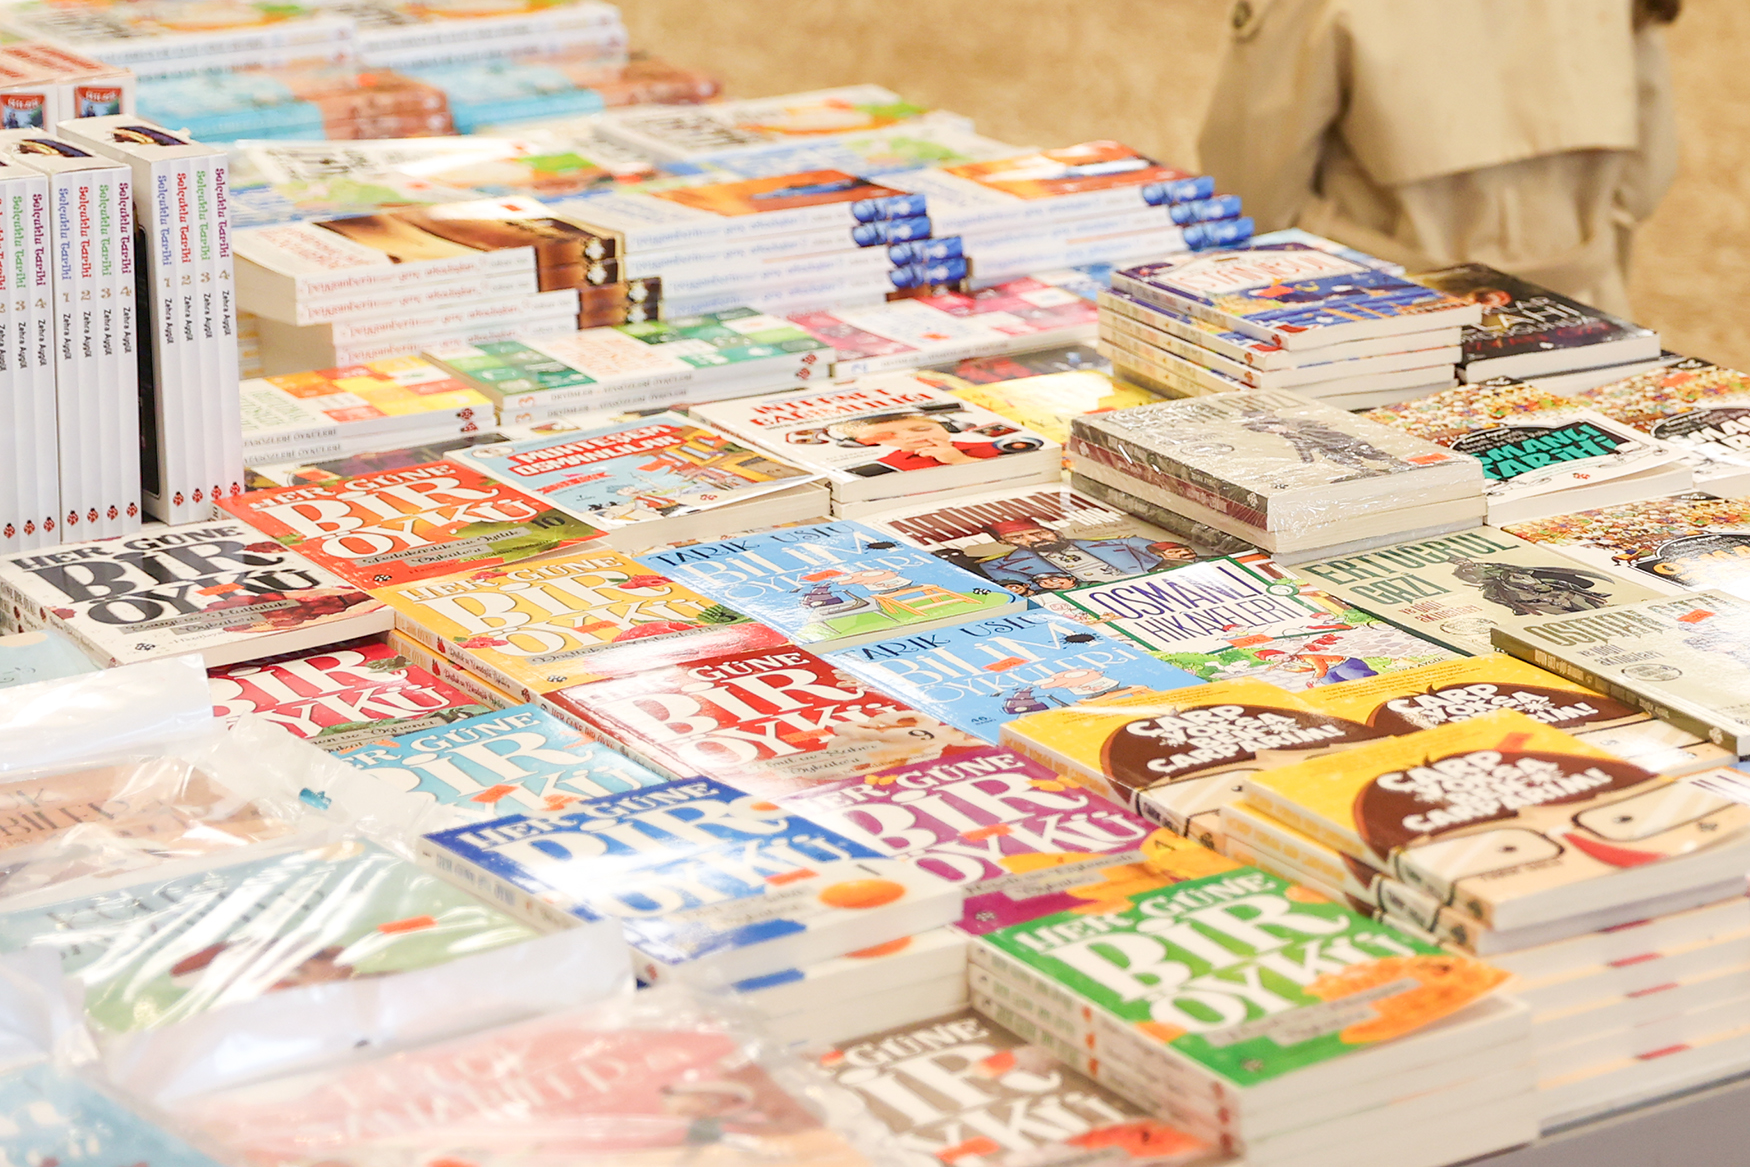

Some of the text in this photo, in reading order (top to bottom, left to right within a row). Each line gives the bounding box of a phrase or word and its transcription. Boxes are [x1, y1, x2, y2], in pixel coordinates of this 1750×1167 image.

[513, 435, 682, 476] OSMANLILAR
[517, 424, 671, 465] MUHTEŞEM
[1470, 424, 1601, 464] SMANLI
[248, 464, 457, 511] HER GÜNE
[263, 477, 500, 541] BİR
[10, 525, 246, 570] HER GÜNE
[321, 499, 539, 559] ÖYKÜ
[530, 514, 567, 531] 10
[25, 540, 285, 605] BİR
[649, 539, 760, 567] TARIK
[675, 531, 902, 586] BİLİM
[1301, 532, 1521, 586] ERTUĞRUL
[88, 567, 325, 626] ÖYKÜ
[397, 557, 626, 604] HER GÜNE
[414, 570, 674, 635] BİR
[1089, 566, 1264, 620] OSMANLI
[1349, 572, 1453, 605] GAZİ
[490, 598, 710, 657] ÖYKÜ
[871, 622, 1106, 686] BİLİM
[687, 652, 810, 681] GÜNE
[258, 685, 450, 738] YKÜ
[615, 668, 866, 736] BİR
[1165, 712, 1298, 742] YOKSA
[410, 711, 542, 752] GÜNE
[896, 752, 1026, 790] GÜNE
[455, 781, 720, 848] HER GÜNE
[812, 772, 1089, 856] BİR
[907, 810, 1149, 886] ÖYKÜ
[1015, 872, 1280, 951] HER GÜNE
[1038, 894, 1352, 1003] BİR
[845, 1018, 991, 1068] GÜNE
